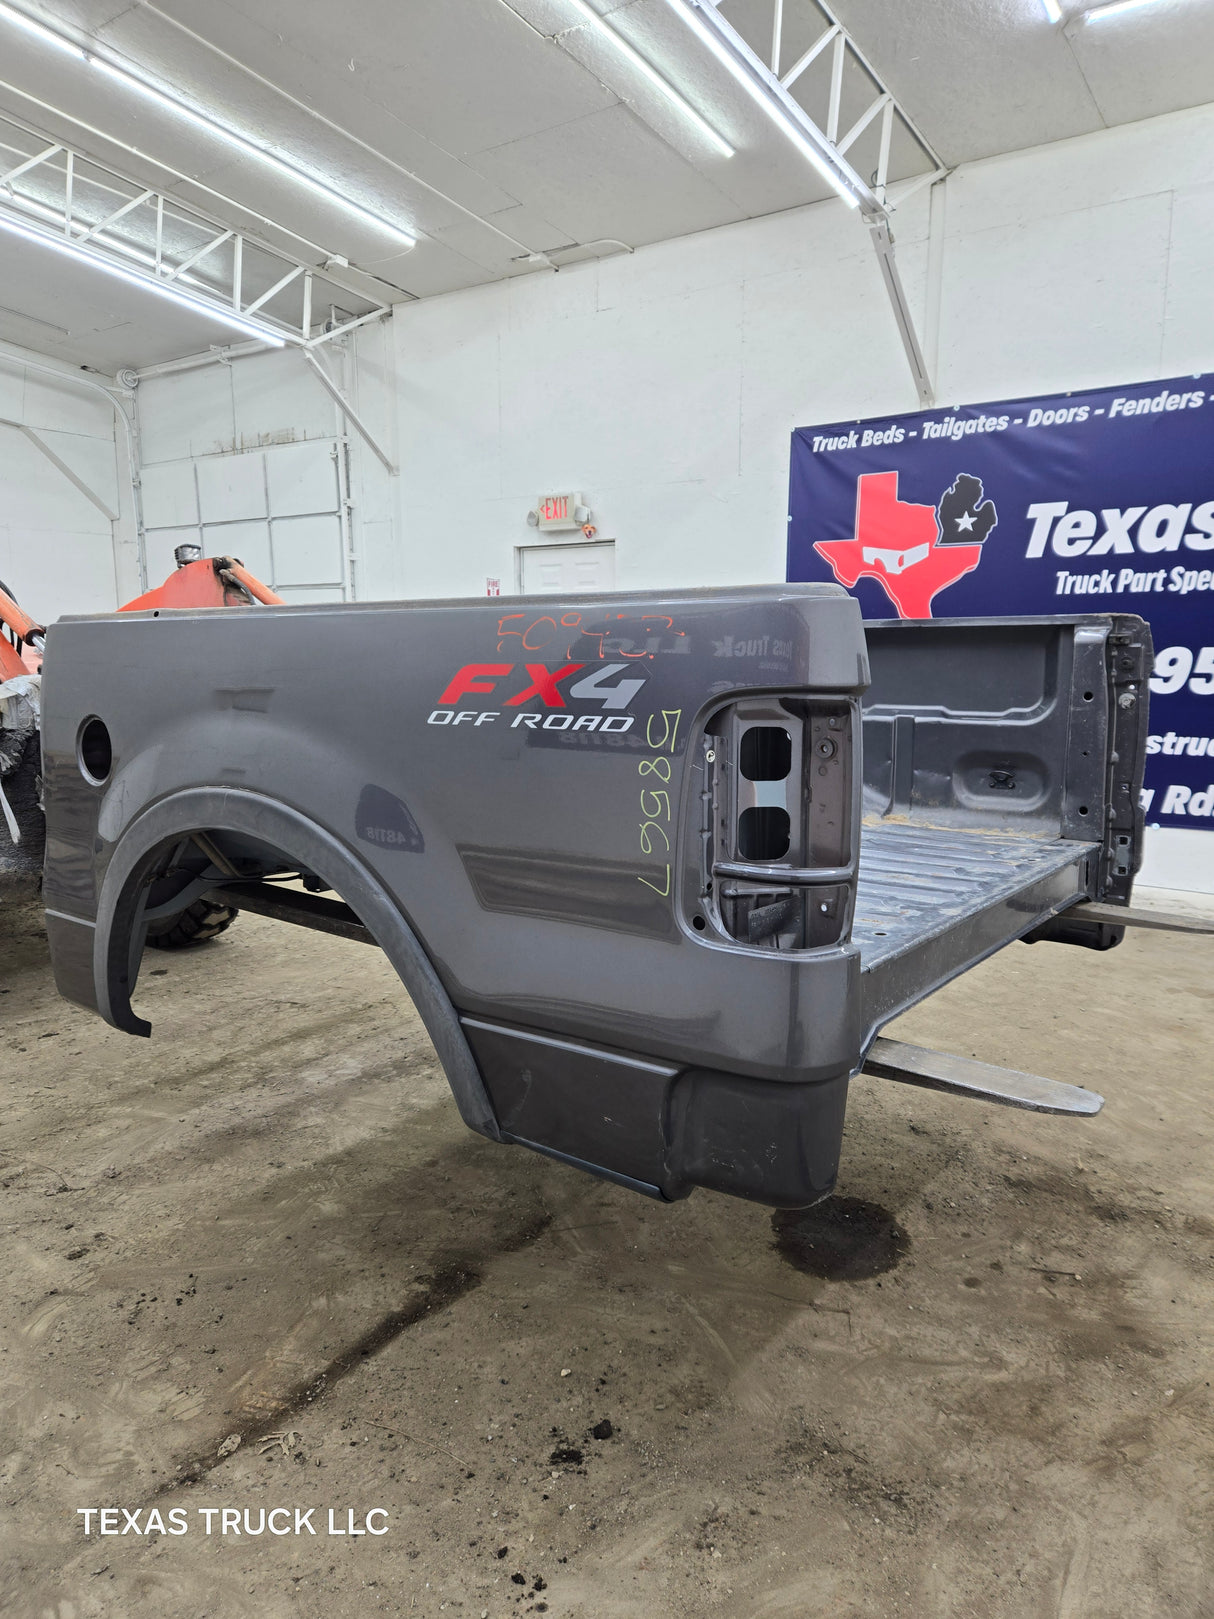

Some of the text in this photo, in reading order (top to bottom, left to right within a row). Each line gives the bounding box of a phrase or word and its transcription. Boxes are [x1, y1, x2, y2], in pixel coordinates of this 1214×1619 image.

[812, 430, 859, 453] Truck
[861, 425, 906, 447] Beds
[922, 415, 1010, 441] Tailgates
[1026, 405, 1091, 428] Doors
[1108, 390, 1206, 418] Fenders
[545, 496, 569, 520] EXIT
[1024, 500, 1214, 558] Texas
[1056, 565, 1214, 595] Truck Part Spe
[437, 663, 647, 710] FX4
[426, 710, 637, 733] OFF ROAD
